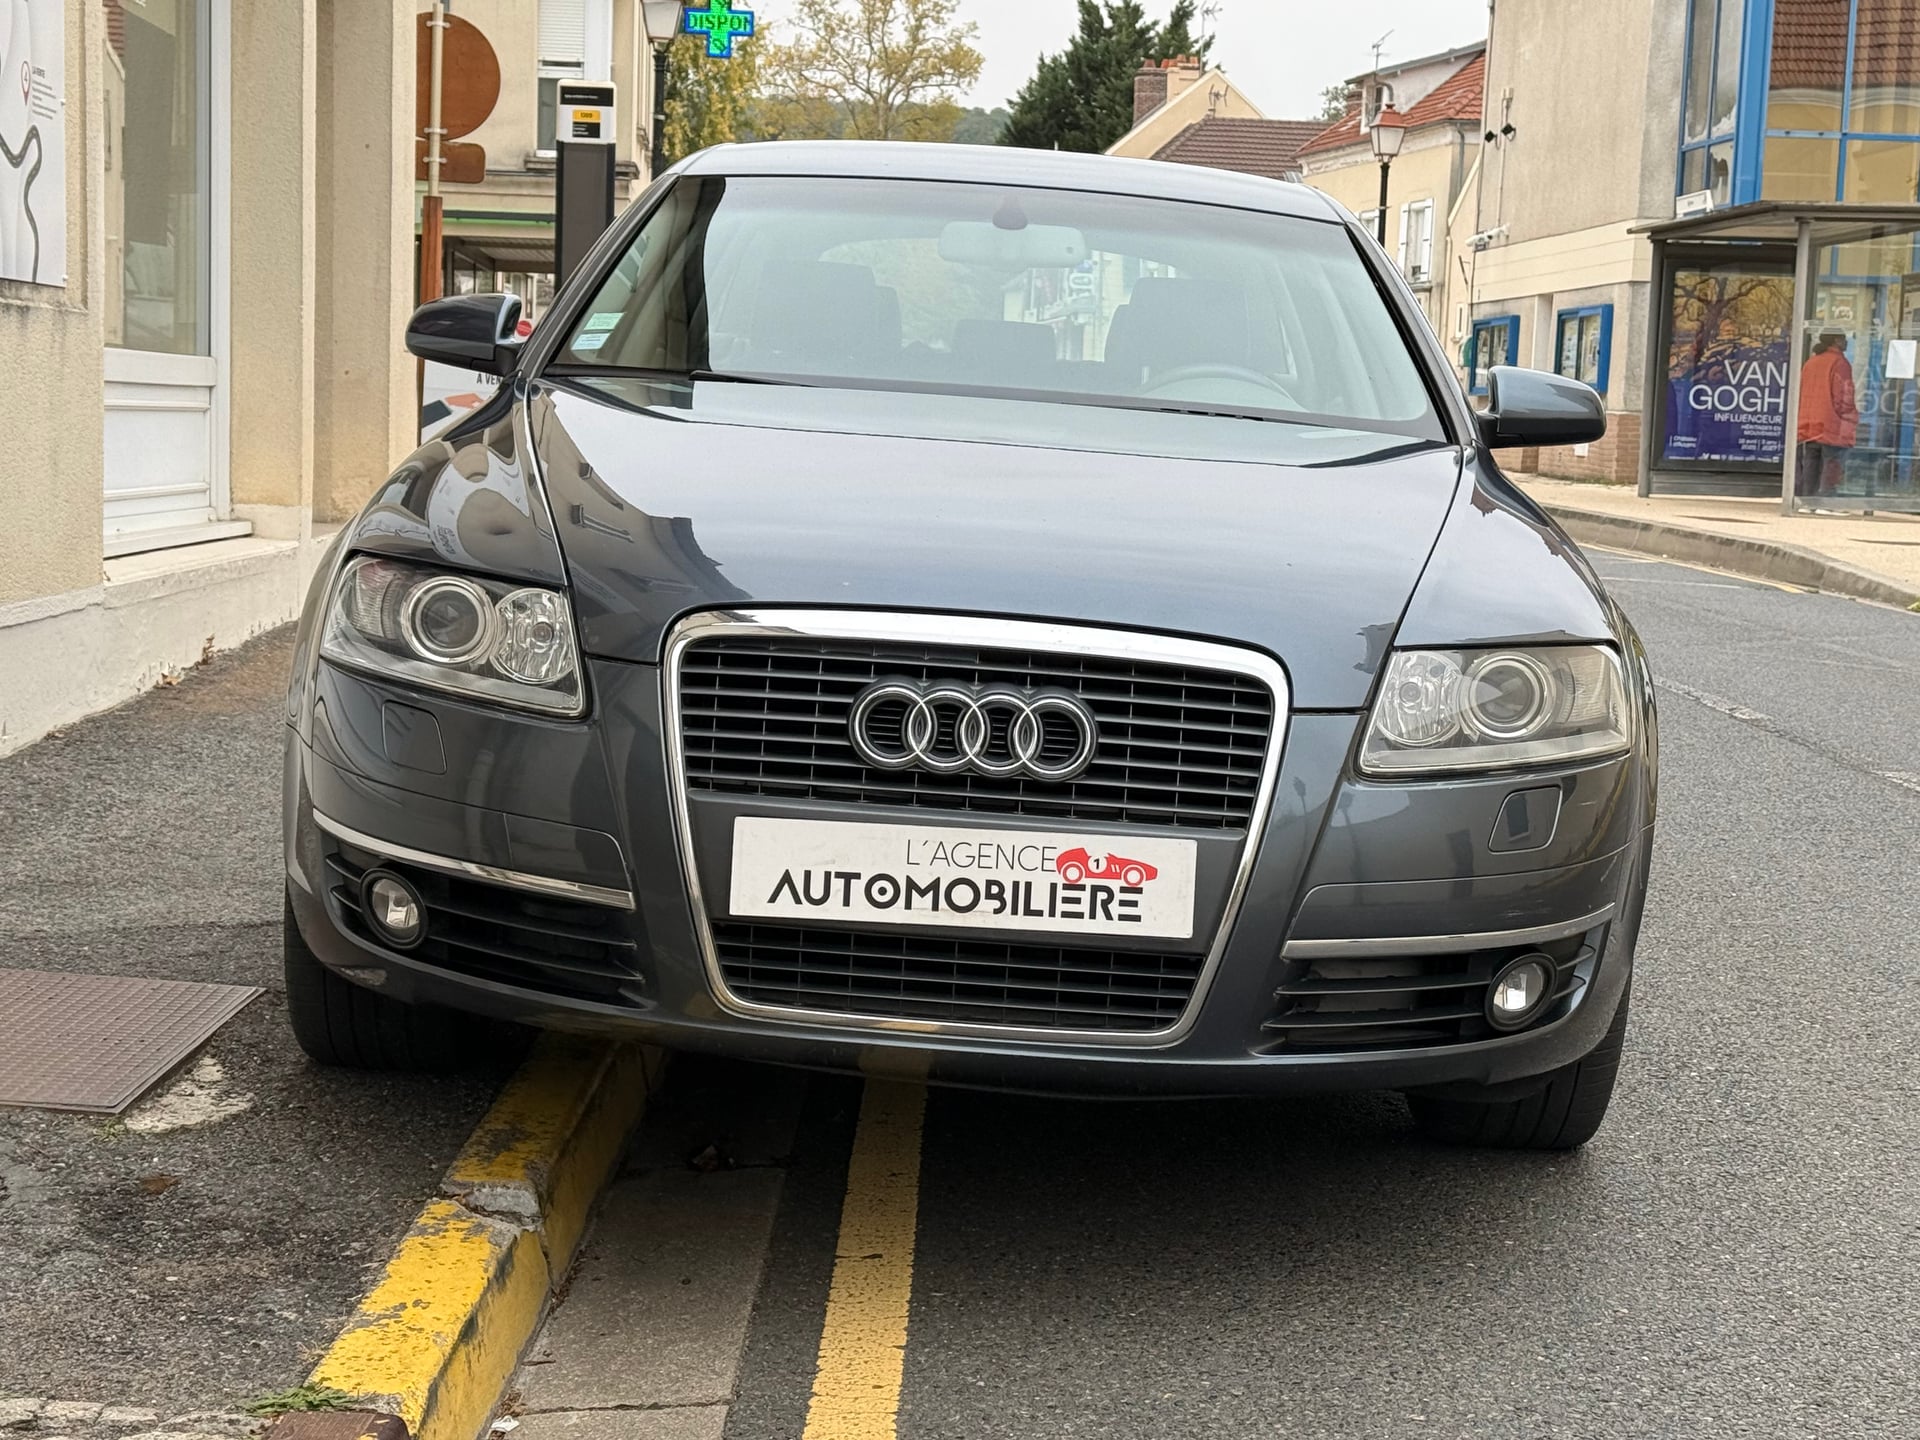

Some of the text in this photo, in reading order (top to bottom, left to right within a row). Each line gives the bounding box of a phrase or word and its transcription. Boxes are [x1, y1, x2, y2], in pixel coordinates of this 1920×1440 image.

[1724, 360, 1787, 387] VAN
[1689, 384, 1785, 413] GOGH
[1714, 413, 1783, 424] INFLUENCEUR
[906, 839, 1058, 873] L'AGENCE
